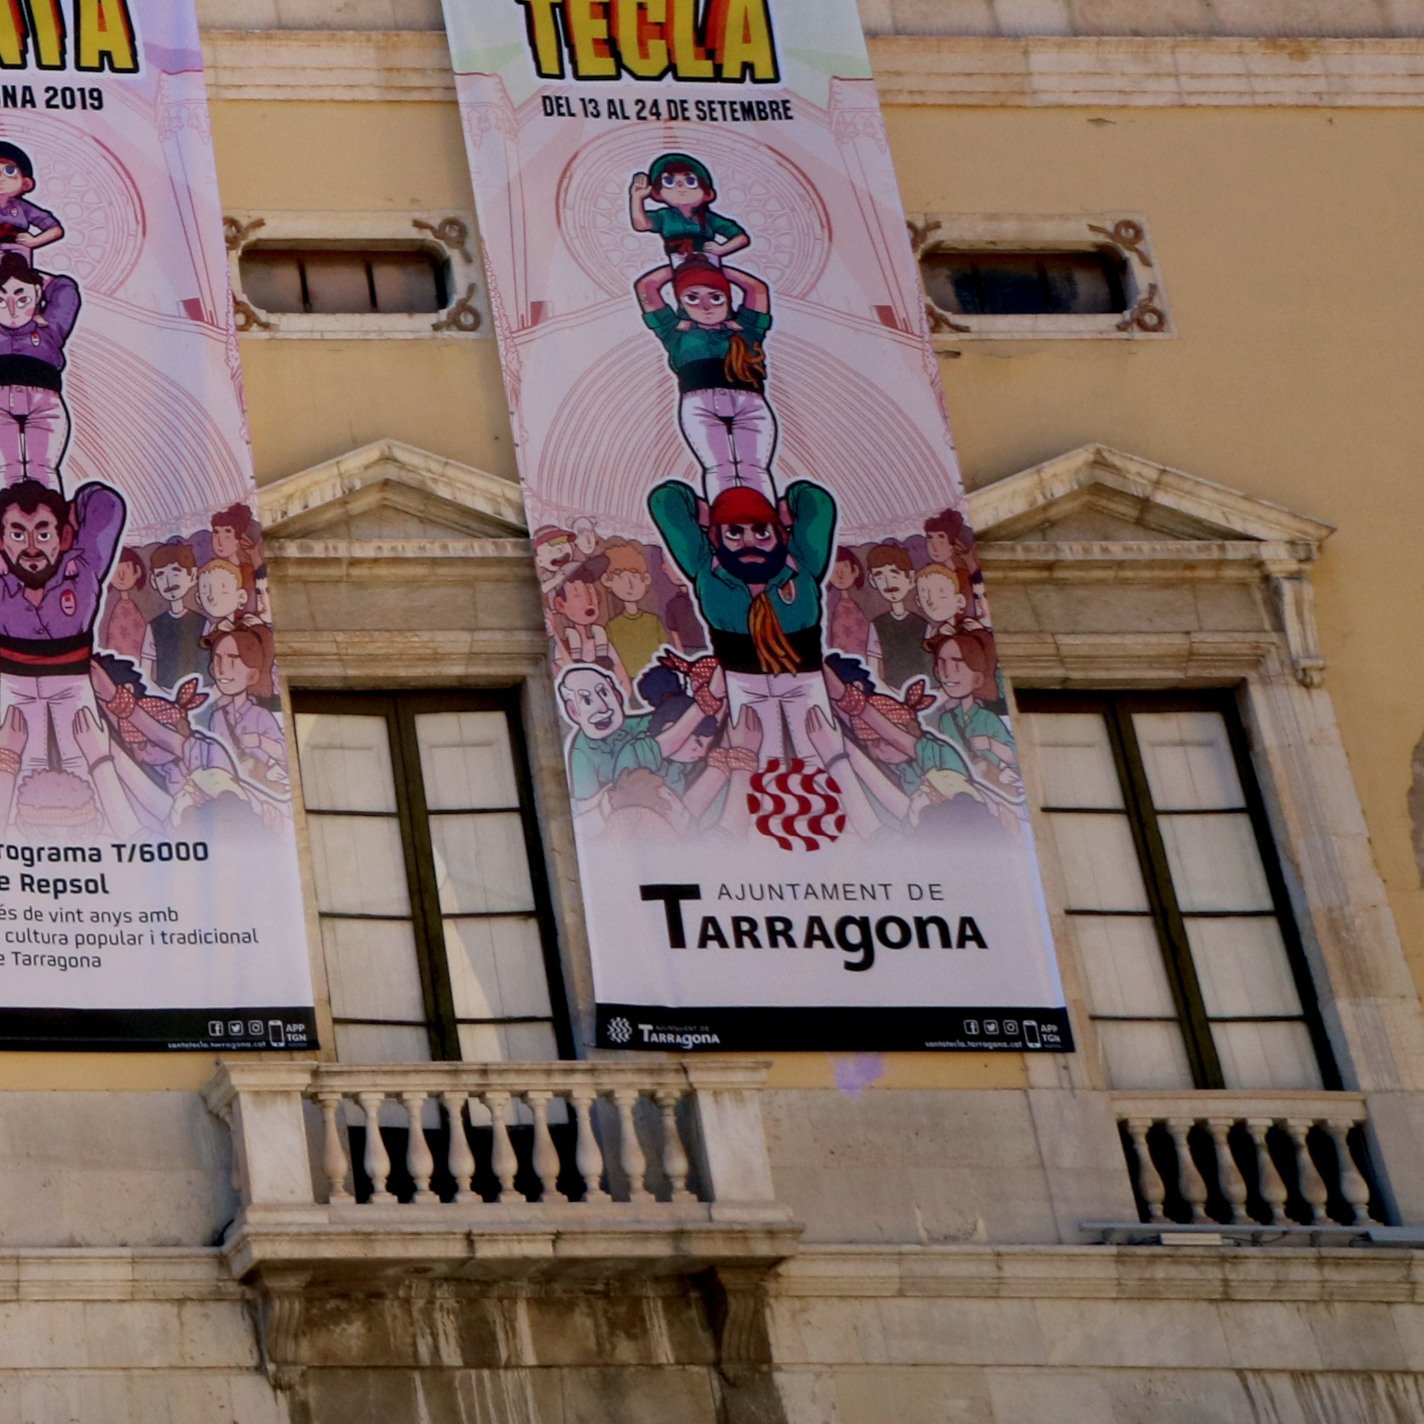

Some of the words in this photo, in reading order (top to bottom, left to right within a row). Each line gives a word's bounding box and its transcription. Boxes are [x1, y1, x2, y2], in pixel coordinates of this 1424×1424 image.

[44, 86, 104, 110] 2019
[541, 95, 576, 118] DEL
[579, 97, 601, 119] 13
[607, 98, 630, 120] AL
[634, 98, 662, 121] 24
[666, 98, 691, 121] DE
[694, 99, 794, 122] SETEMBRE
[111, 841, 209, 863] T/6000
[19, 872, 110, 899] Repsol
[717, 883, 893, 901] AJUNTAMENT
[907, 883, 945, 901] DE
[23, 906, 43, 922] de
[48, 907, 84, 923] vint
[90, 909, 133, 927] anys
[138, 906, 179, 923] amb
[5, 927, 68, 946] cultura
[74, 930, 144, 949] popular
[150, 929, 156, 945] i
[161, 927, 260, 945] tradicional
[10, 951, 102, 972] Tarragona
[285, 1023, 306, 1033] APP
[286, 1033, 307, 1042] TGN
[1041, 1033, 1061, 1043] TGN
